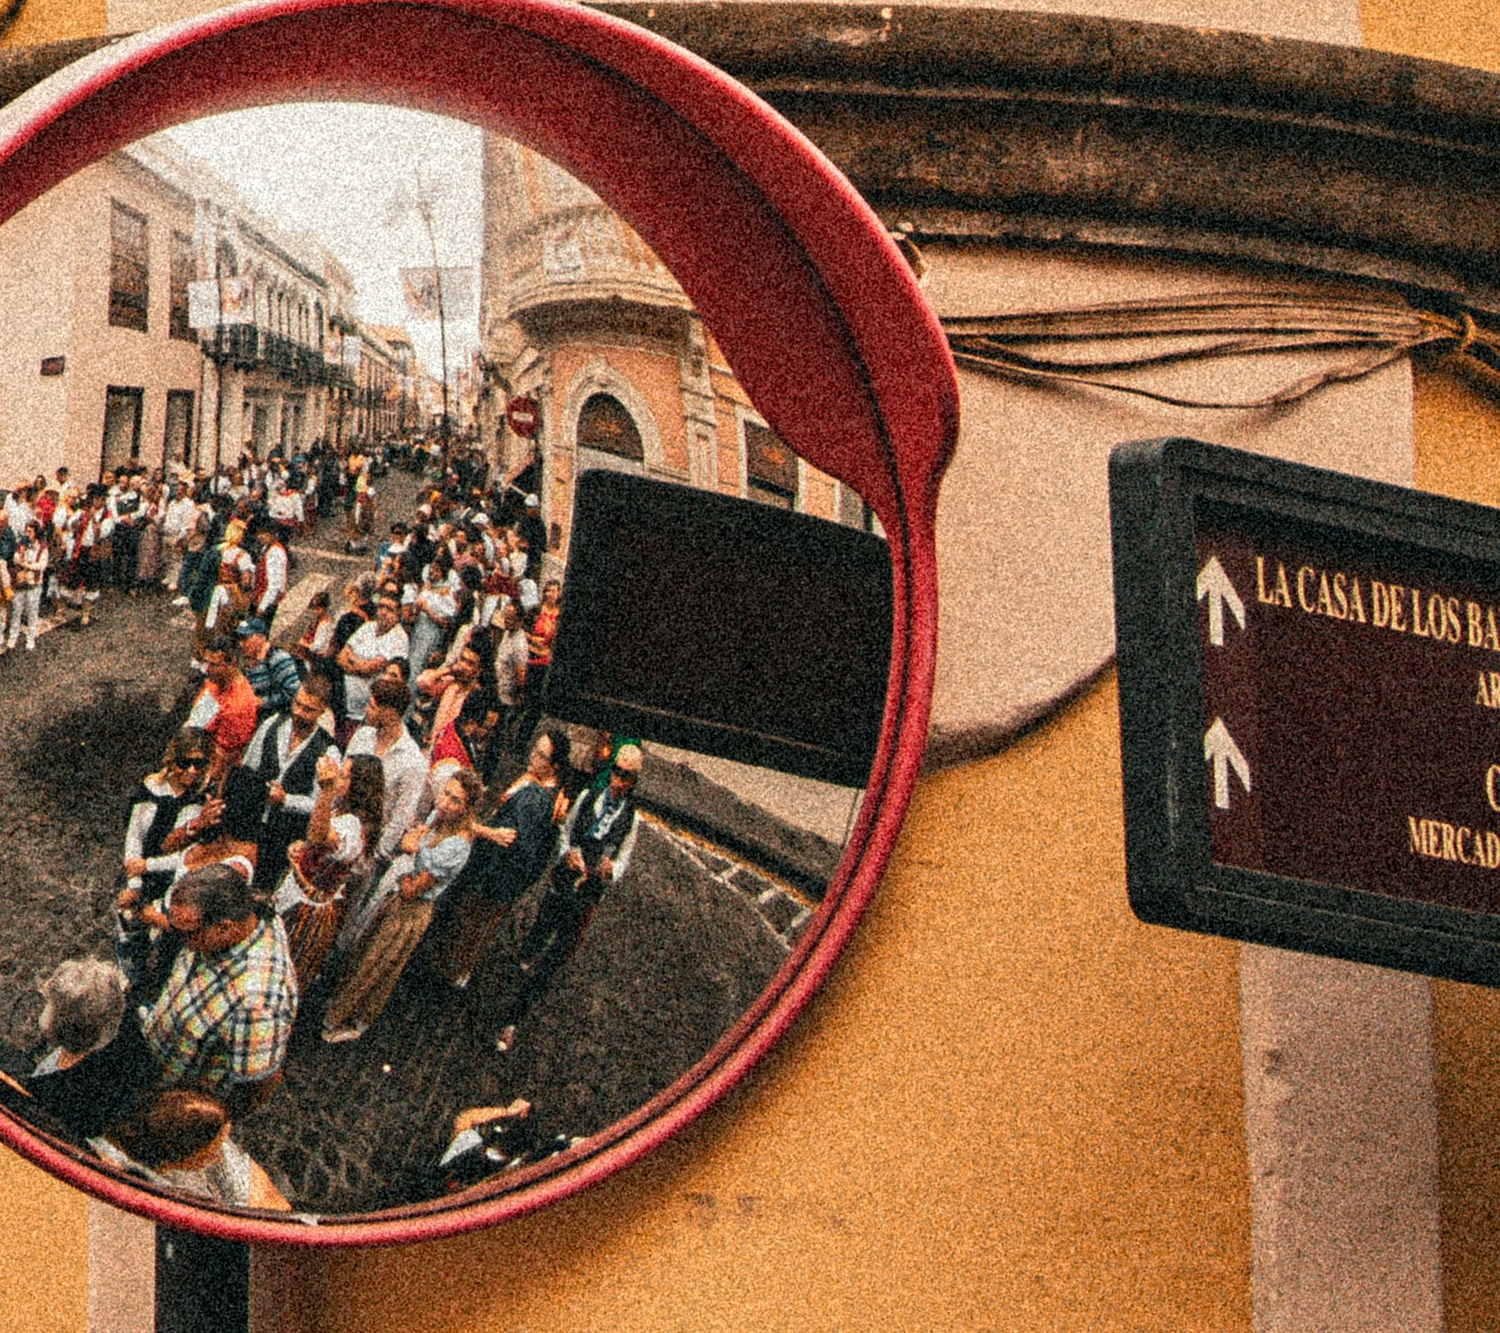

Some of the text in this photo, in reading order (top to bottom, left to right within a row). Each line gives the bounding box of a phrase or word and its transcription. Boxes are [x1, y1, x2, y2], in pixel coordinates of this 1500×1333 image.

[1256, 556, 1293, 608] LA
[1298, 565, 1367, 623] CASA
[1371, 581, 1407, 632] DE
[1411, 588, 1461, 644] LOS
[1408, 815, 1500, 869] MERCAD
